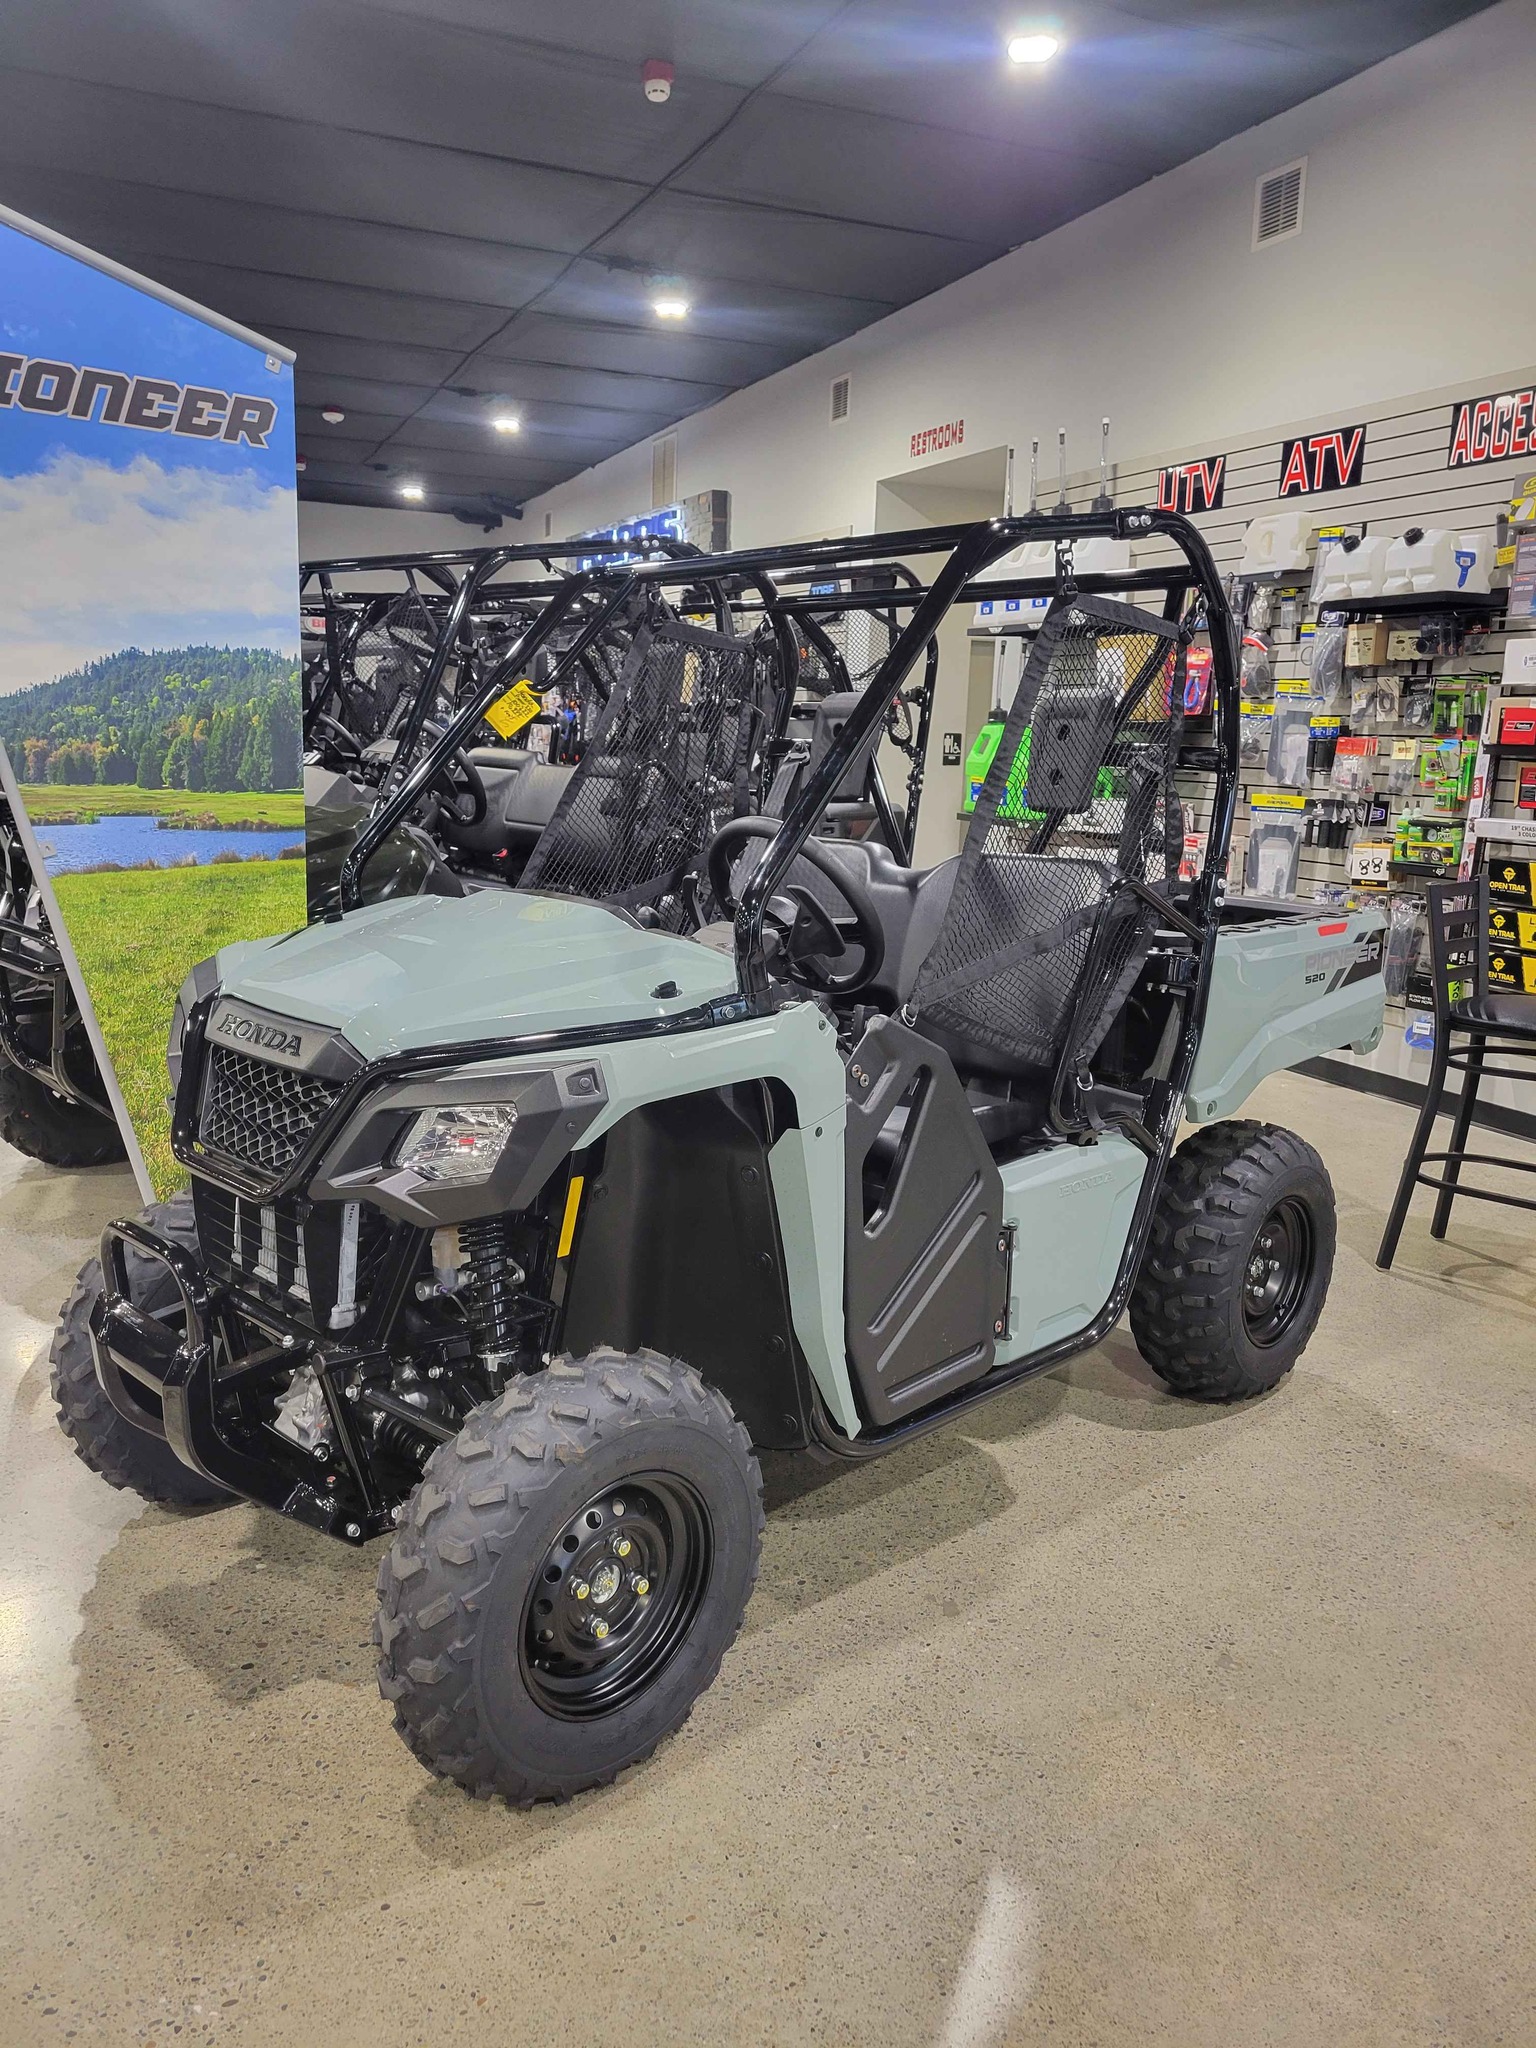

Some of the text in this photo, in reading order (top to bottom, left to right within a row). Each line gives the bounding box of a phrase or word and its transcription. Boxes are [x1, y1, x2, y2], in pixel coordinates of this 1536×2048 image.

[910, 419, 964, 458] RESTROOMS
[1280, 428, 1364, 496] ATV
[1157, 456, 1225, 512] UTV
[1489, 881, 1508, 890] OPEN
[1508, 883, 1527, 893] TRAIL
[1489, 928, 1498, 937] EN
[1498, 929, 1516, 939] TRAIL
[1305, 942, 1380, 972] PIONEER
[1305, 972, 1326, 985] 520
[1488, 971, 1498, 979] EN
[1498, 972, 1516, 982] TRAIL
[1409, 993, 1433, 1002] SYNTHETIC
[216, 1013, 302, 1057] HONDA
[1059, 1170, 1115, 1199] HONDA
